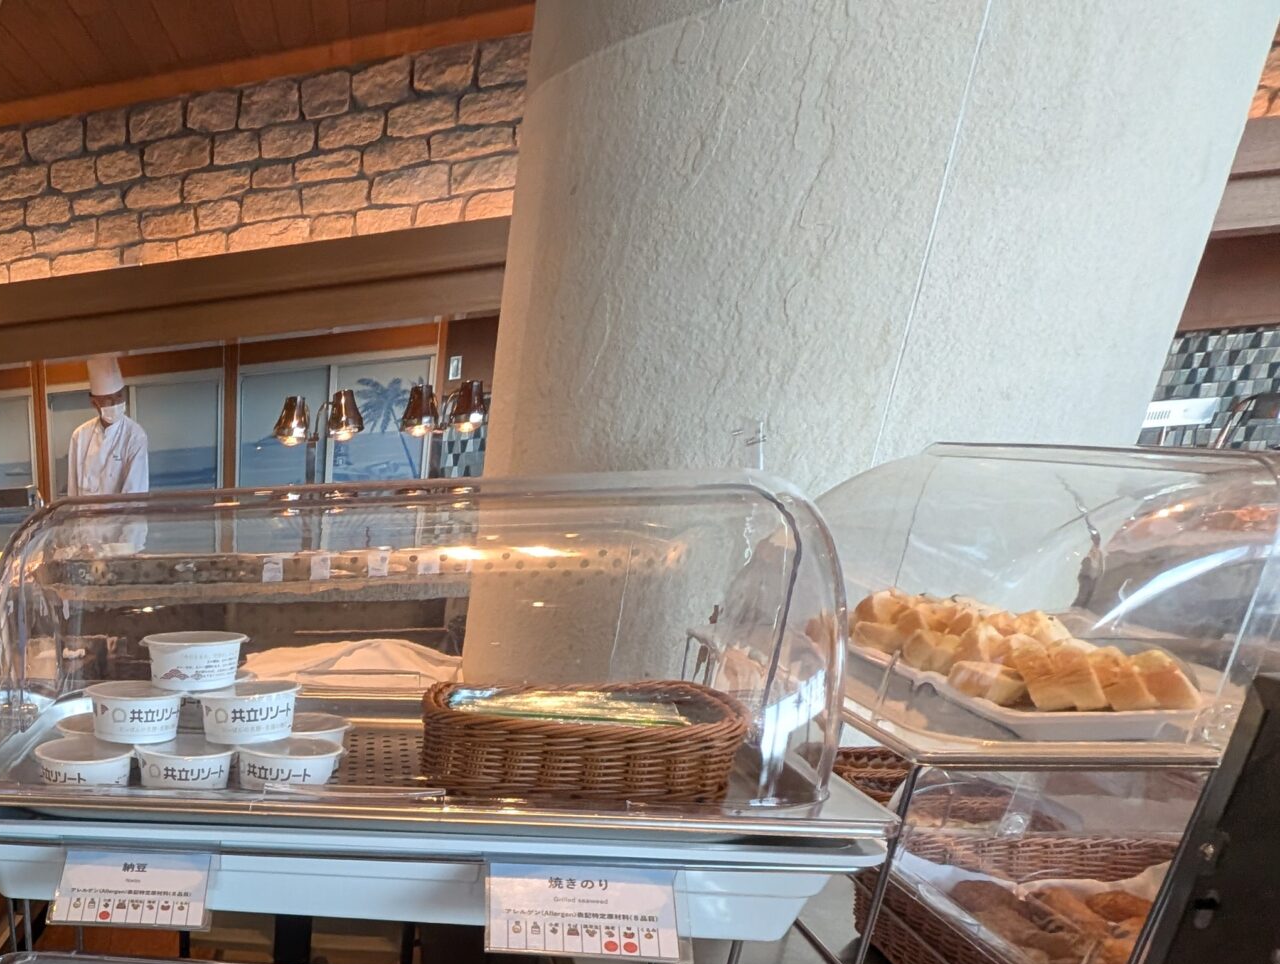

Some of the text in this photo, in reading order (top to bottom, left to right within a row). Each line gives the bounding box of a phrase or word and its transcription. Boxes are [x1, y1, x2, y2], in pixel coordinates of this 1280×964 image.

[122, 862, 148, 872] 納豆
[548, 876, 610, 890] 焼きのり
[553, 896, 576, 904] Grilled
